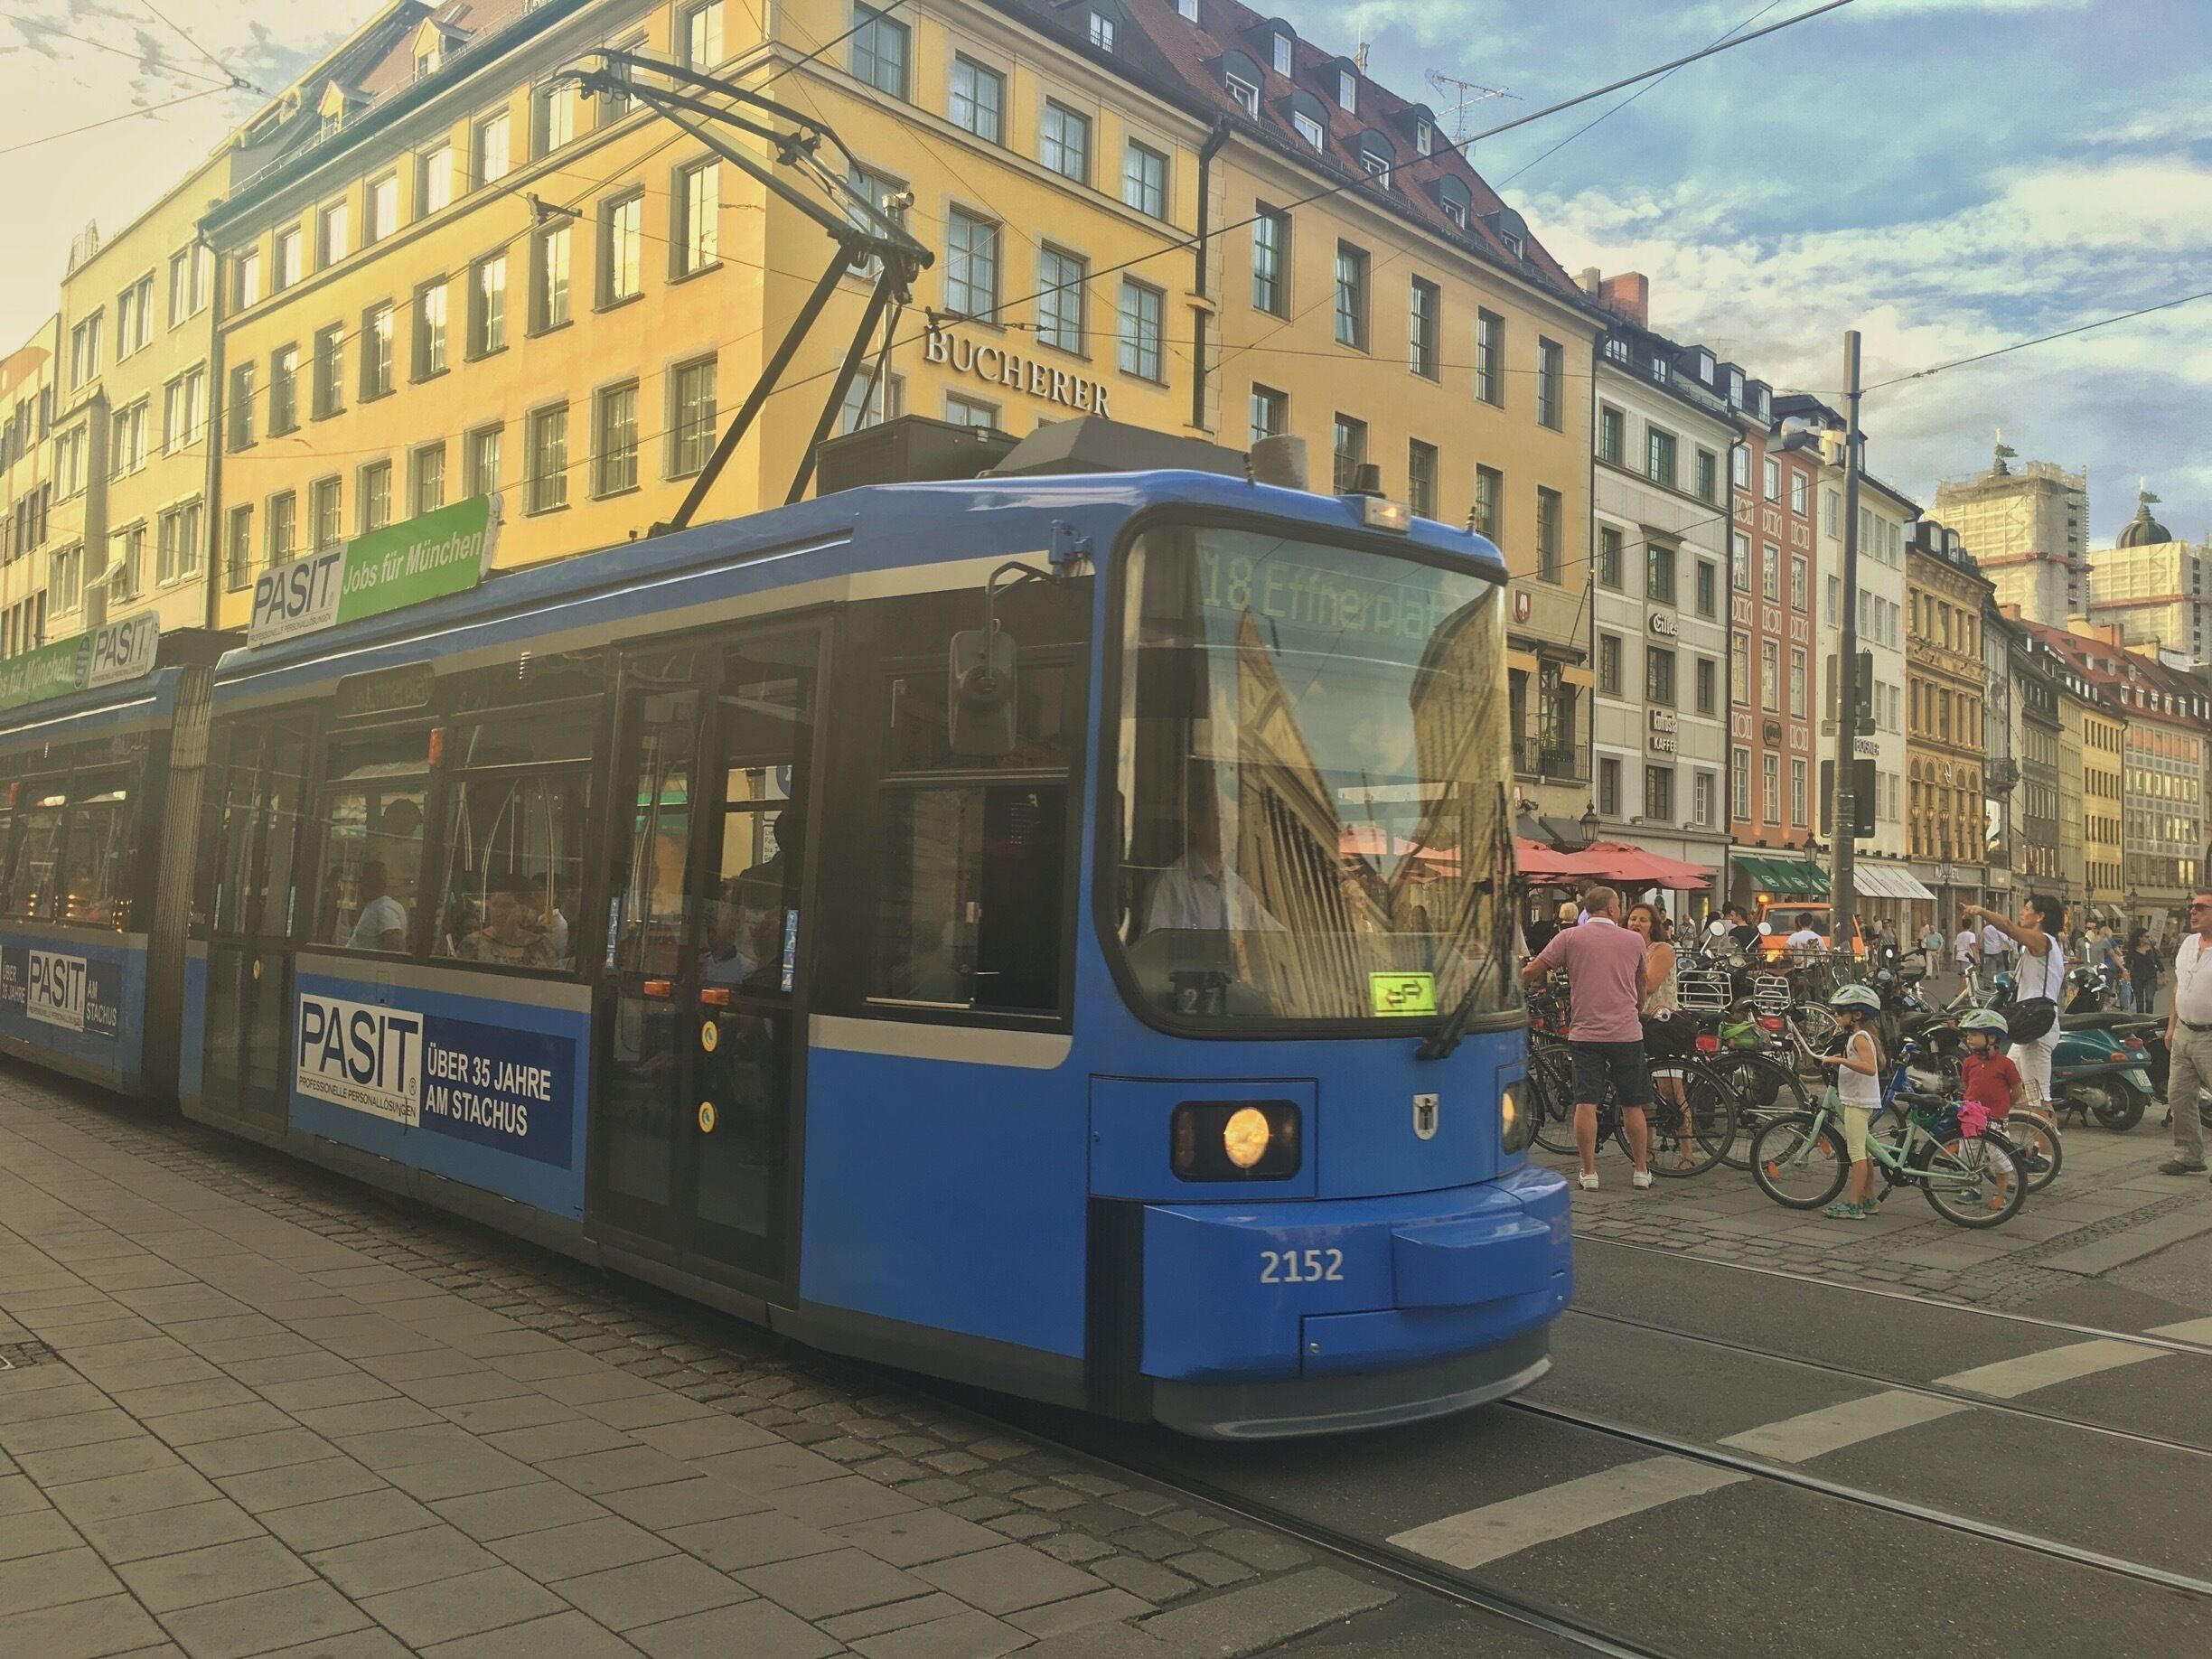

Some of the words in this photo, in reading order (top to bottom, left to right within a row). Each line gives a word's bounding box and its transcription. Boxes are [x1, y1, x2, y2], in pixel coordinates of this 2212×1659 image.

[924, 328, 1111, 419] BUCHERER
[250, 552, 341, 629] PASIT
[343, 561, 378, 595] Jobs
[380, 550, 404, 583] für
[406, 531, 482, 576] München
[1203, 553, 1253, 612] 18
[93, 617, 153, 672] PASIT
[23, 651, 71, 694] München
[1653, 736, 1678, 753] KAFFEE
[29, 955, 86, 1011] PASIT
[88, 980, 98, 1000] AM
[86, 1002, 117, 1026] STACHUS
[299, 1001, 419, 1093] PASIT
[427, 1042, 468, 1083] ÜBER
[472, 1056, 491, 1087] 35
[494, 1061, 551, 1101] JAHRE
[298, 1075, 347, 1099] PROFESSIONELLE
[347, 1090, 417, 1118] PERSONALLÖSUNGEN
[426, 1084, 448, 1115] AM
[452, 1090, 528, 1136] STACHUS
[1260, 1249, 1345, 1283] 2152
